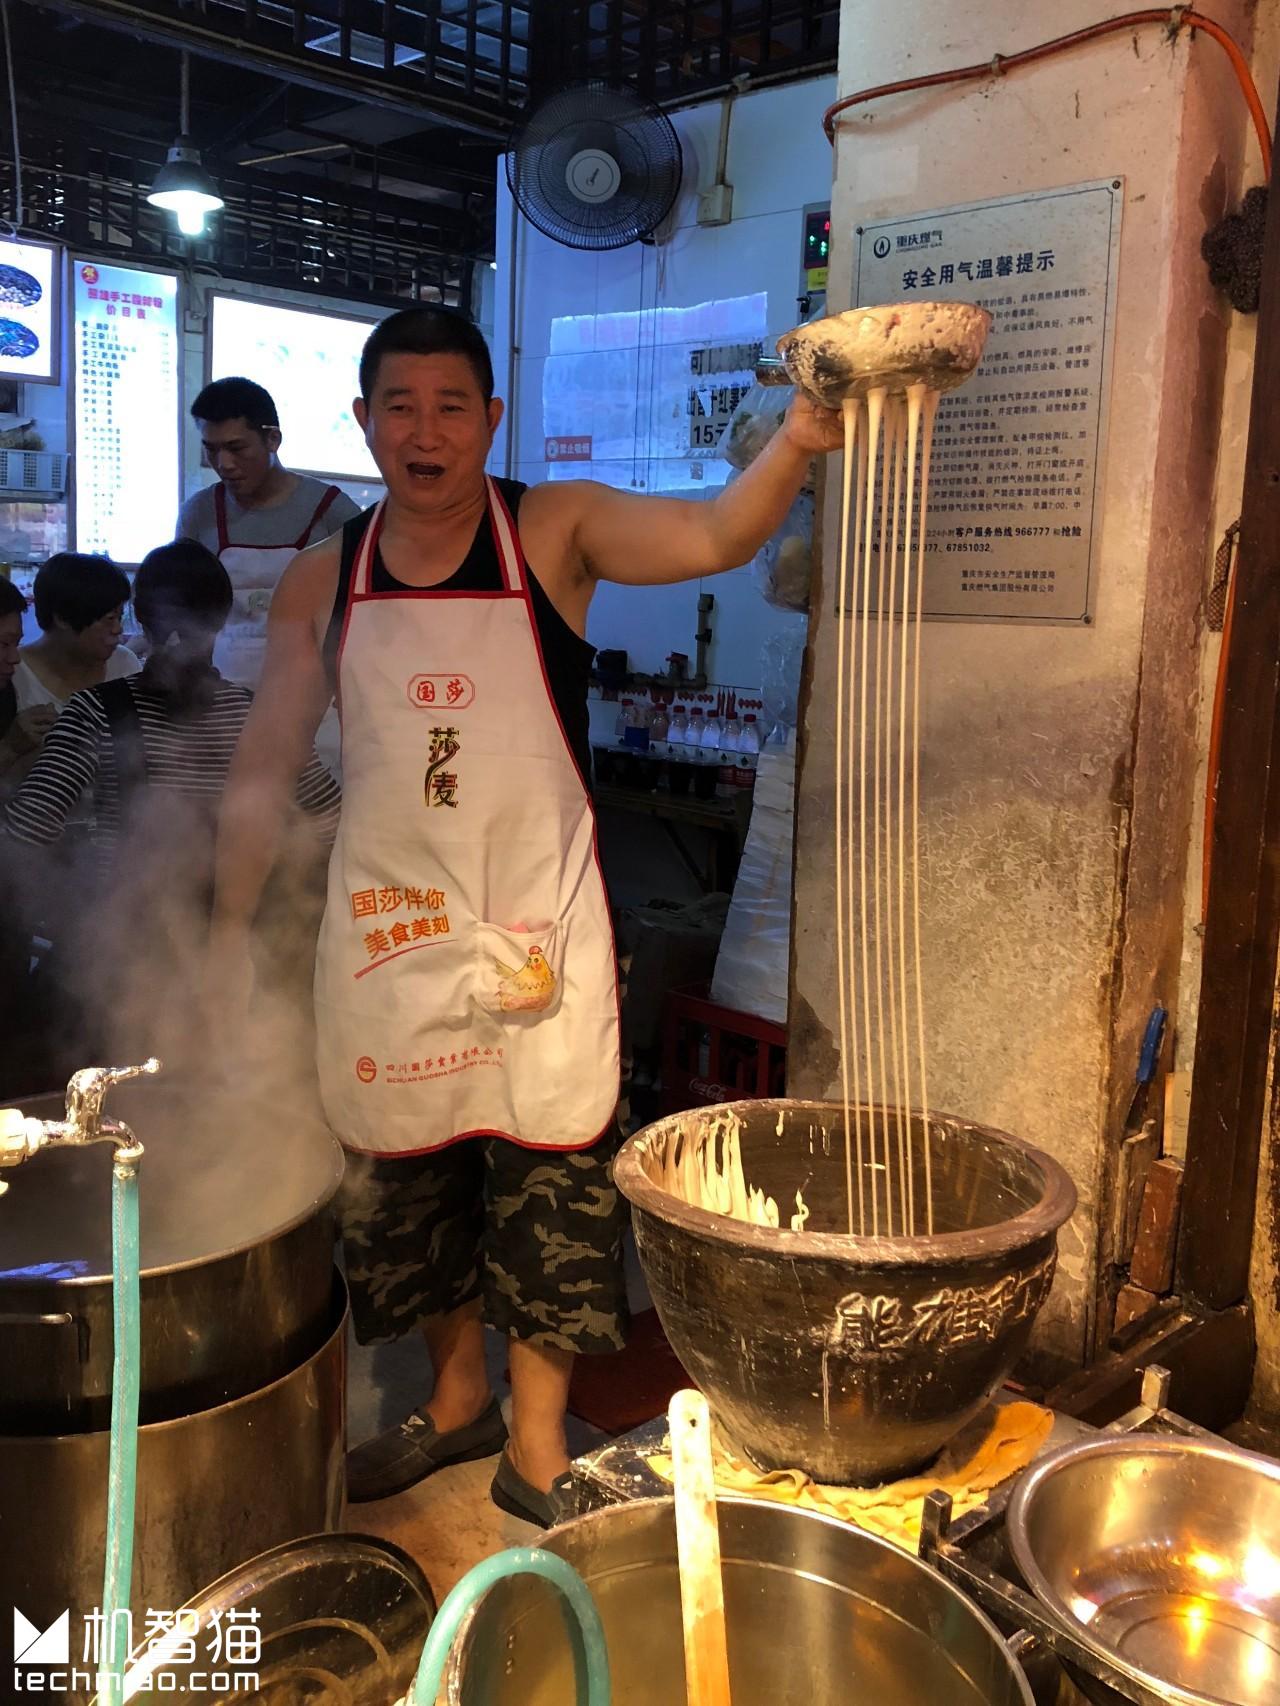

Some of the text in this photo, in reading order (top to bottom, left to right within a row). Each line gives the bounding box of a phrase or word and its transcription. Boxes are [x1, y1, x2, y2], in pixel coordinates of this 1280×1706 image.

[902, 249, 1055, 290] 安全用气温馨提示
[1015, 527, 1050, 537] 966777
[351, 886, 446, 920] 国莎伴你
[363, 914, 450, 960] 美食美刻
